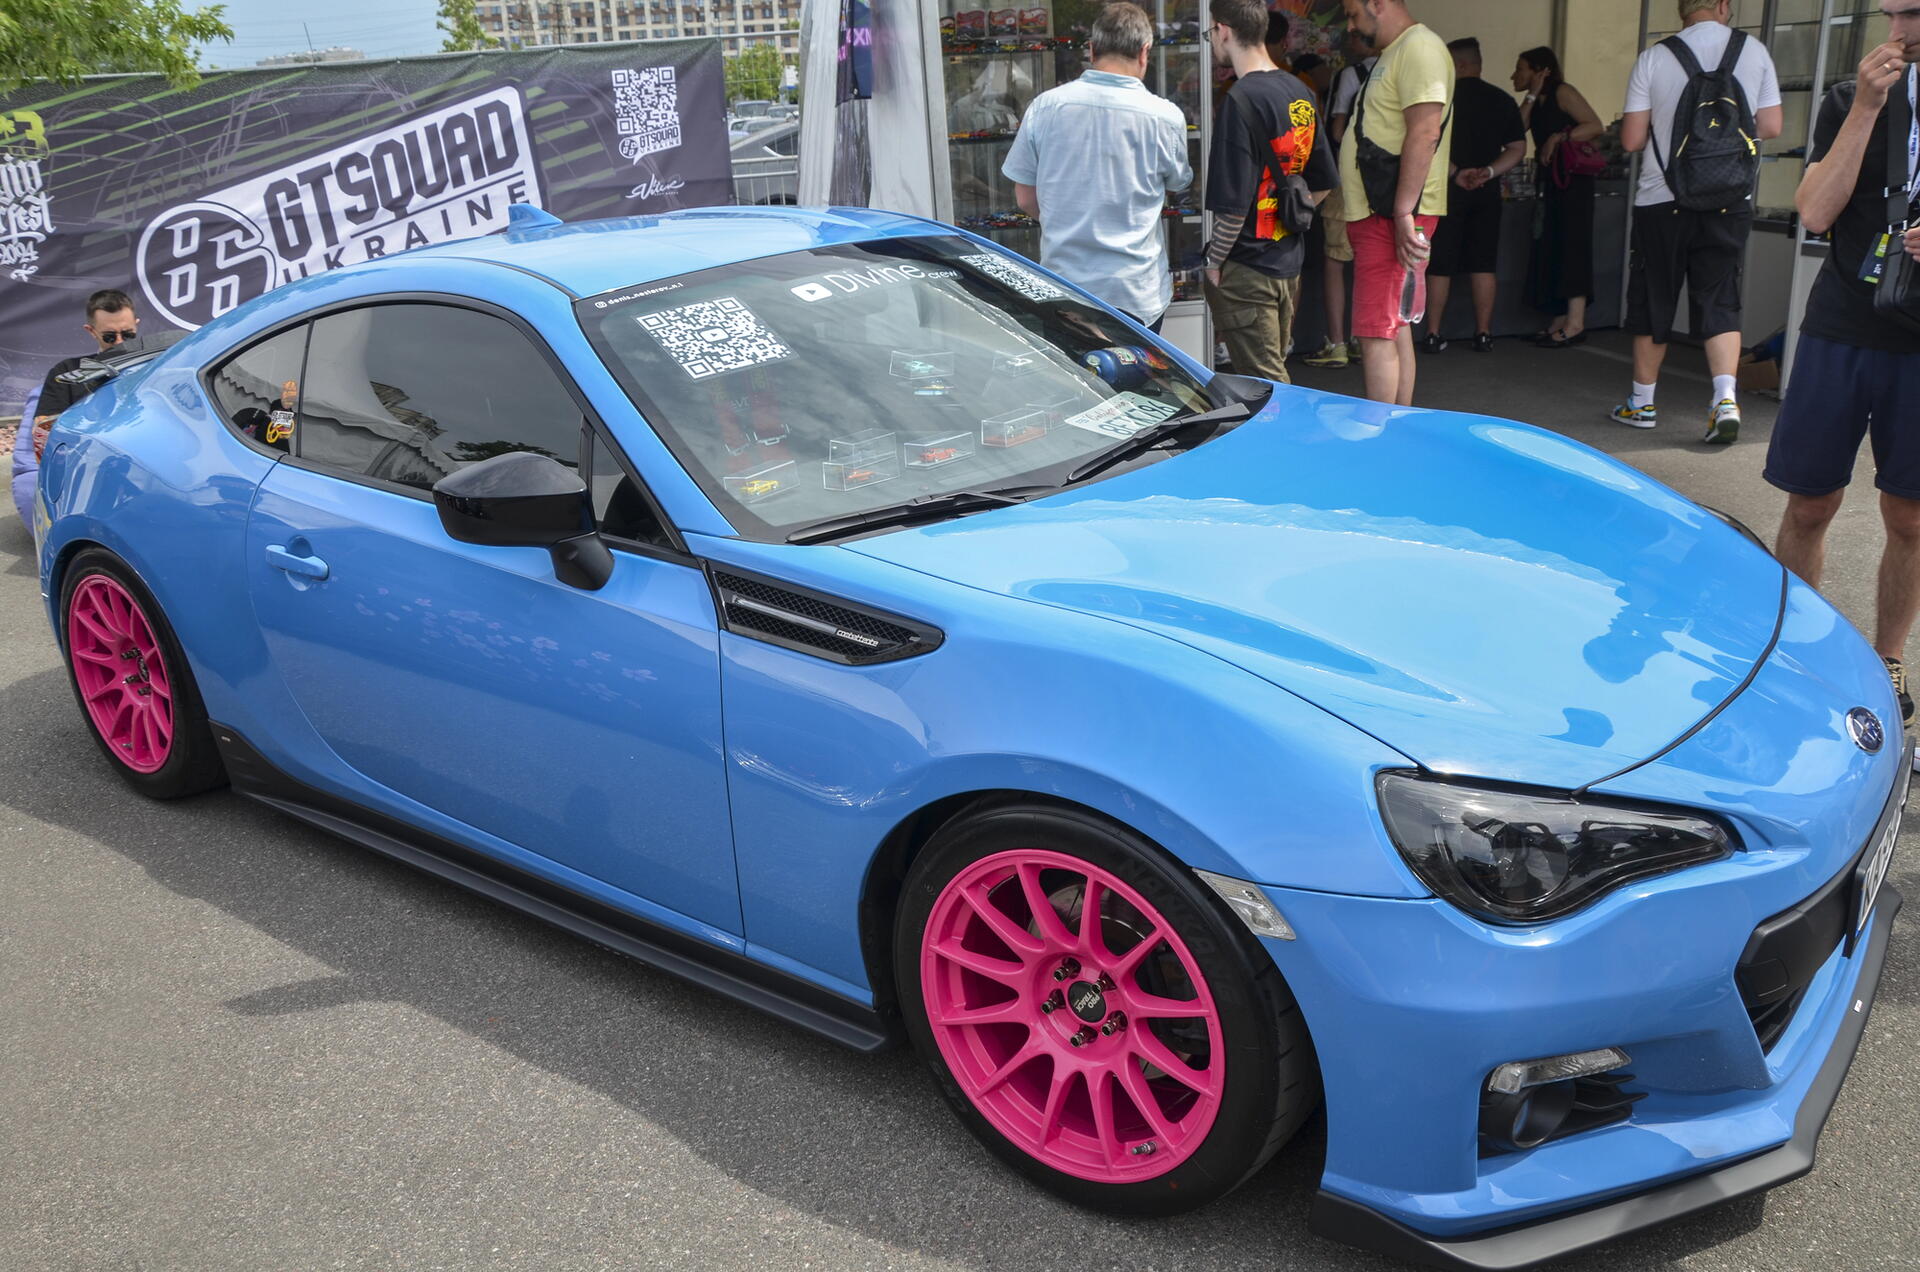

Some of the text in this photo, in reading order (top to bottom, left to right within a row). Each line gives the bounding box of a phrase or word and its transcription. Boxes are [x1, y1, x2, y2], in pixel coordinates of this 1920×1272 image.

[640, 126, 679, 148] GTSQUAD
[263, 100, 519, 262] GTSQUAD
[824, 264, 926, 293] Divine
